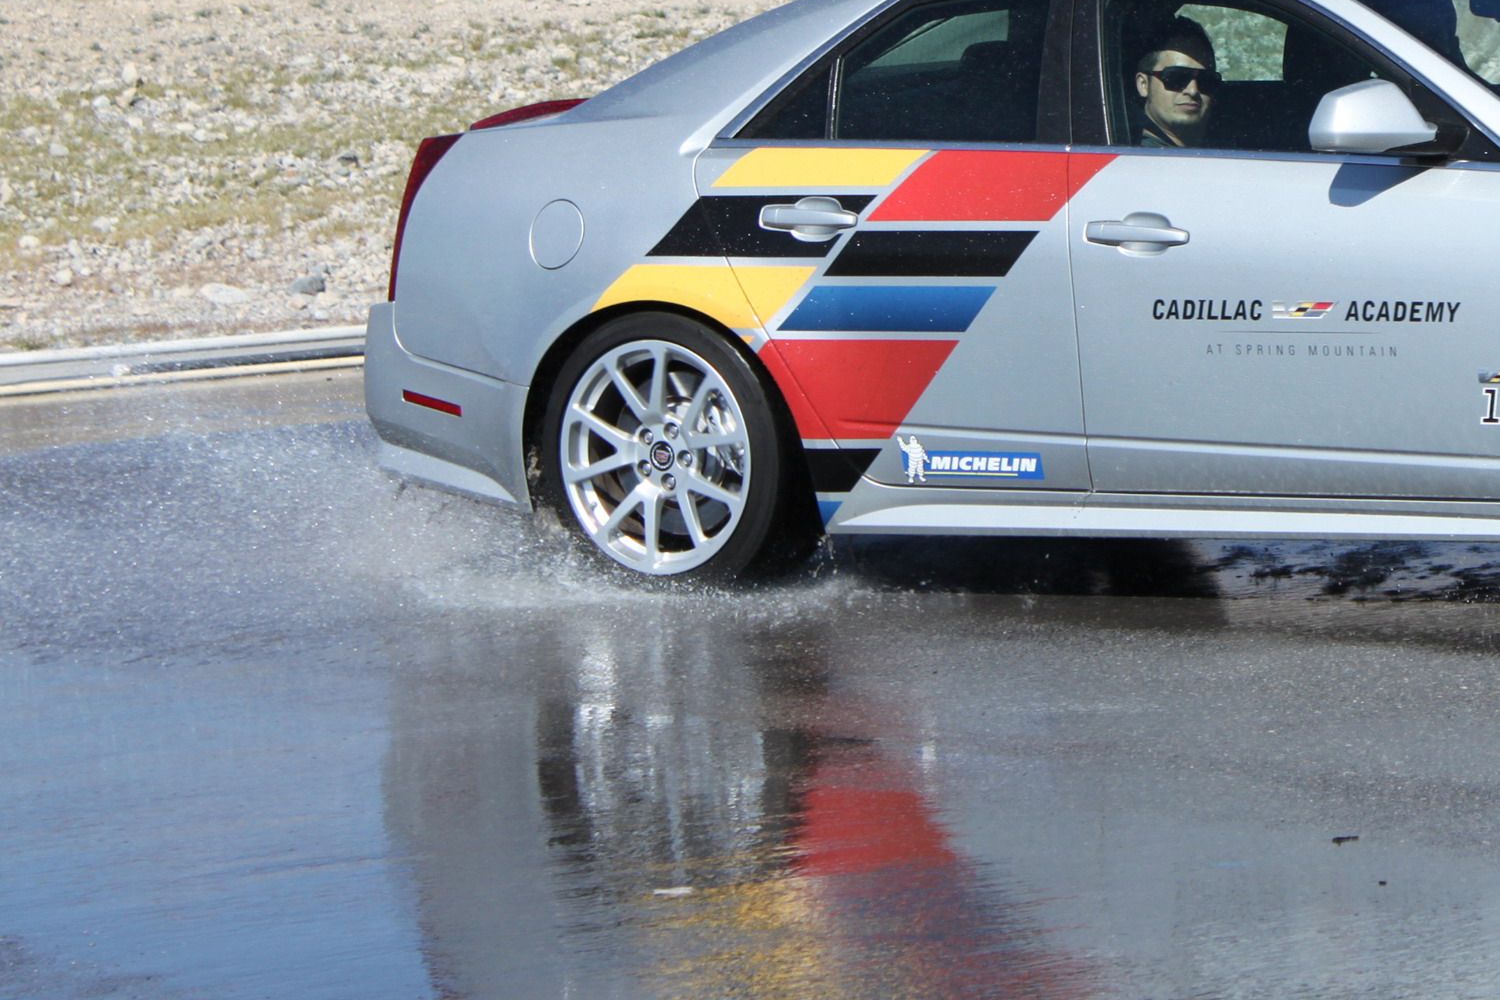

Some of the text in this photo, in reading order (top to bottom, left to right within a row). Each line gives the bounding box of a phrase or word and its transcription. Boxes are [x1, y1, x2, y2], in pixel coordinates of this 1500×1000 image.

[1152, 298, 1462, 323] CADILLAC ACADEMY
[1206, 343, 1398, 358] AT SPRING MOUNTAIN
[931, 456, 1037, 472] MICHELIN
